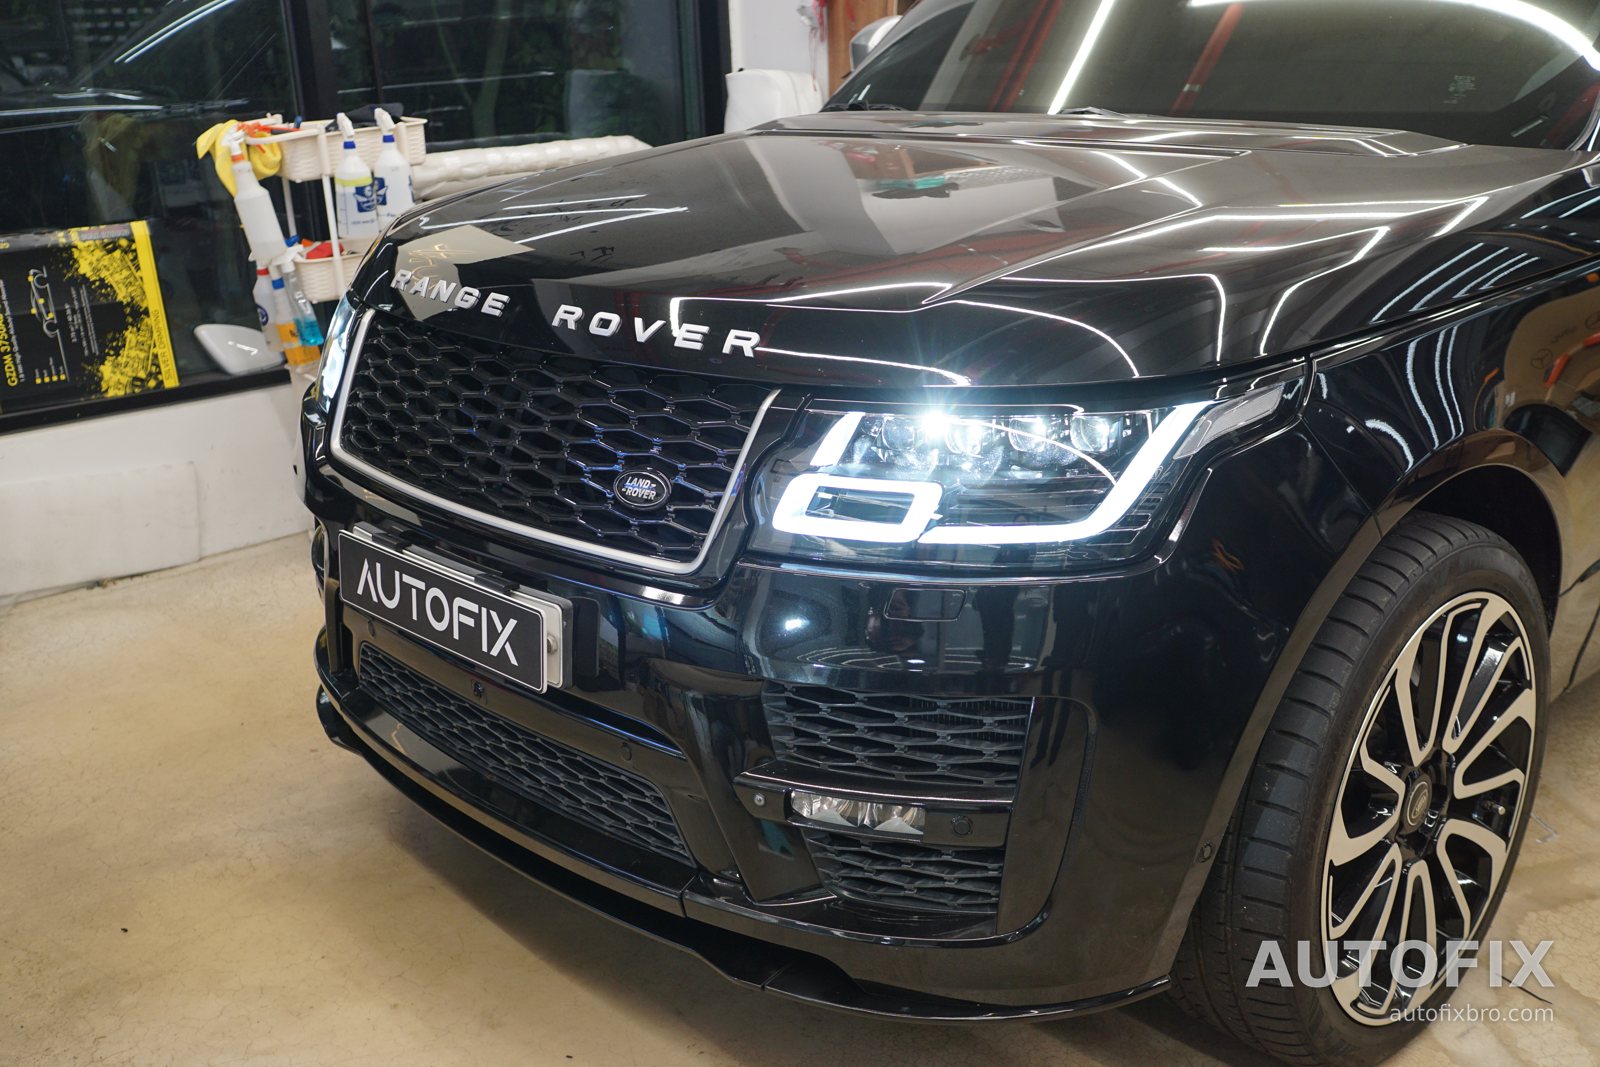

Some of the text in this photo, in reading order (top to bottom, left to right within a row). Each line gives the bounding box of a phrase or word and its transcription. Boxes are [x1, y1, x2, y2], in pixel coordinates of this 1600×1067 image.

[152, 310, 172, 381] SILVER DAMPING
[390, 269, 760, 358] RANGE ROVER
[3, 354, 18, 387] GZDM
[356, 558, 519, 667] AUTOFIX
